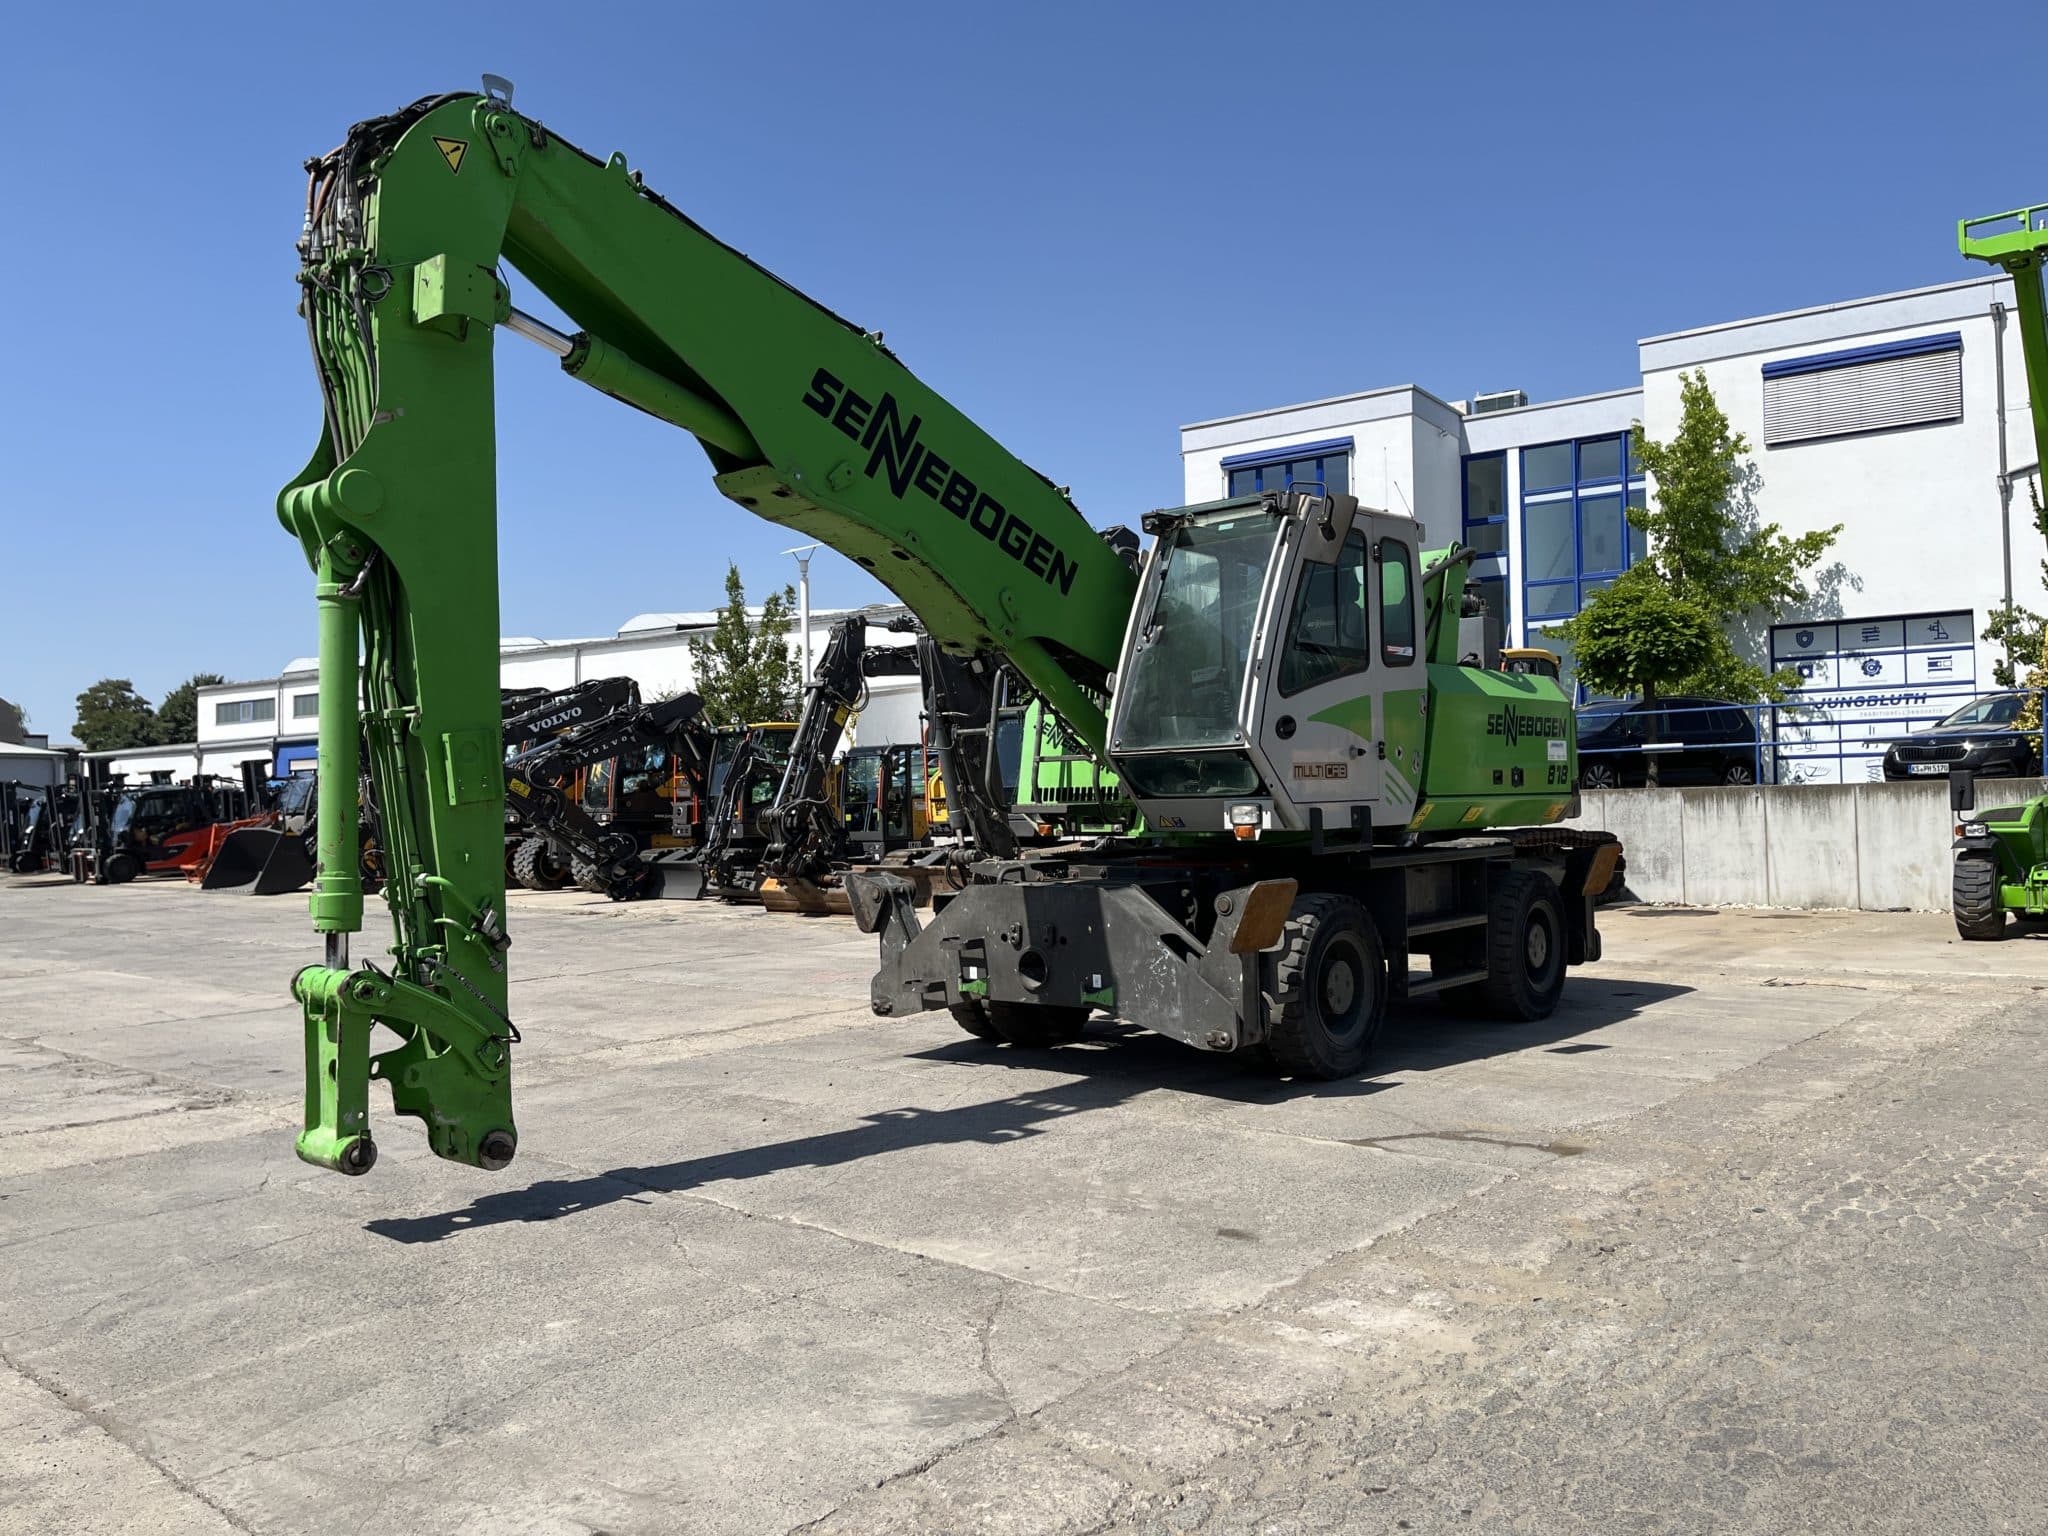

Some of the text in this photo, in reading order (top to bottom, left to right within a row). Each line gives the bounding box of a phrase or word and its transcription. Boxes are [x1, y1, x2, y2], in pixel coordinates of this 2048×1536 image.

[801, 367, 1079, 597] SENNEBOGEN
[527, 706, 582, 733] VOLVO
[1487, 703, 1567, 747] SENNEBOGEN
[580, 735, 628, 758] VOLVO
[1294, 765, 1324, 779] MULTI
[1547, 765, 1569, 785] 818
